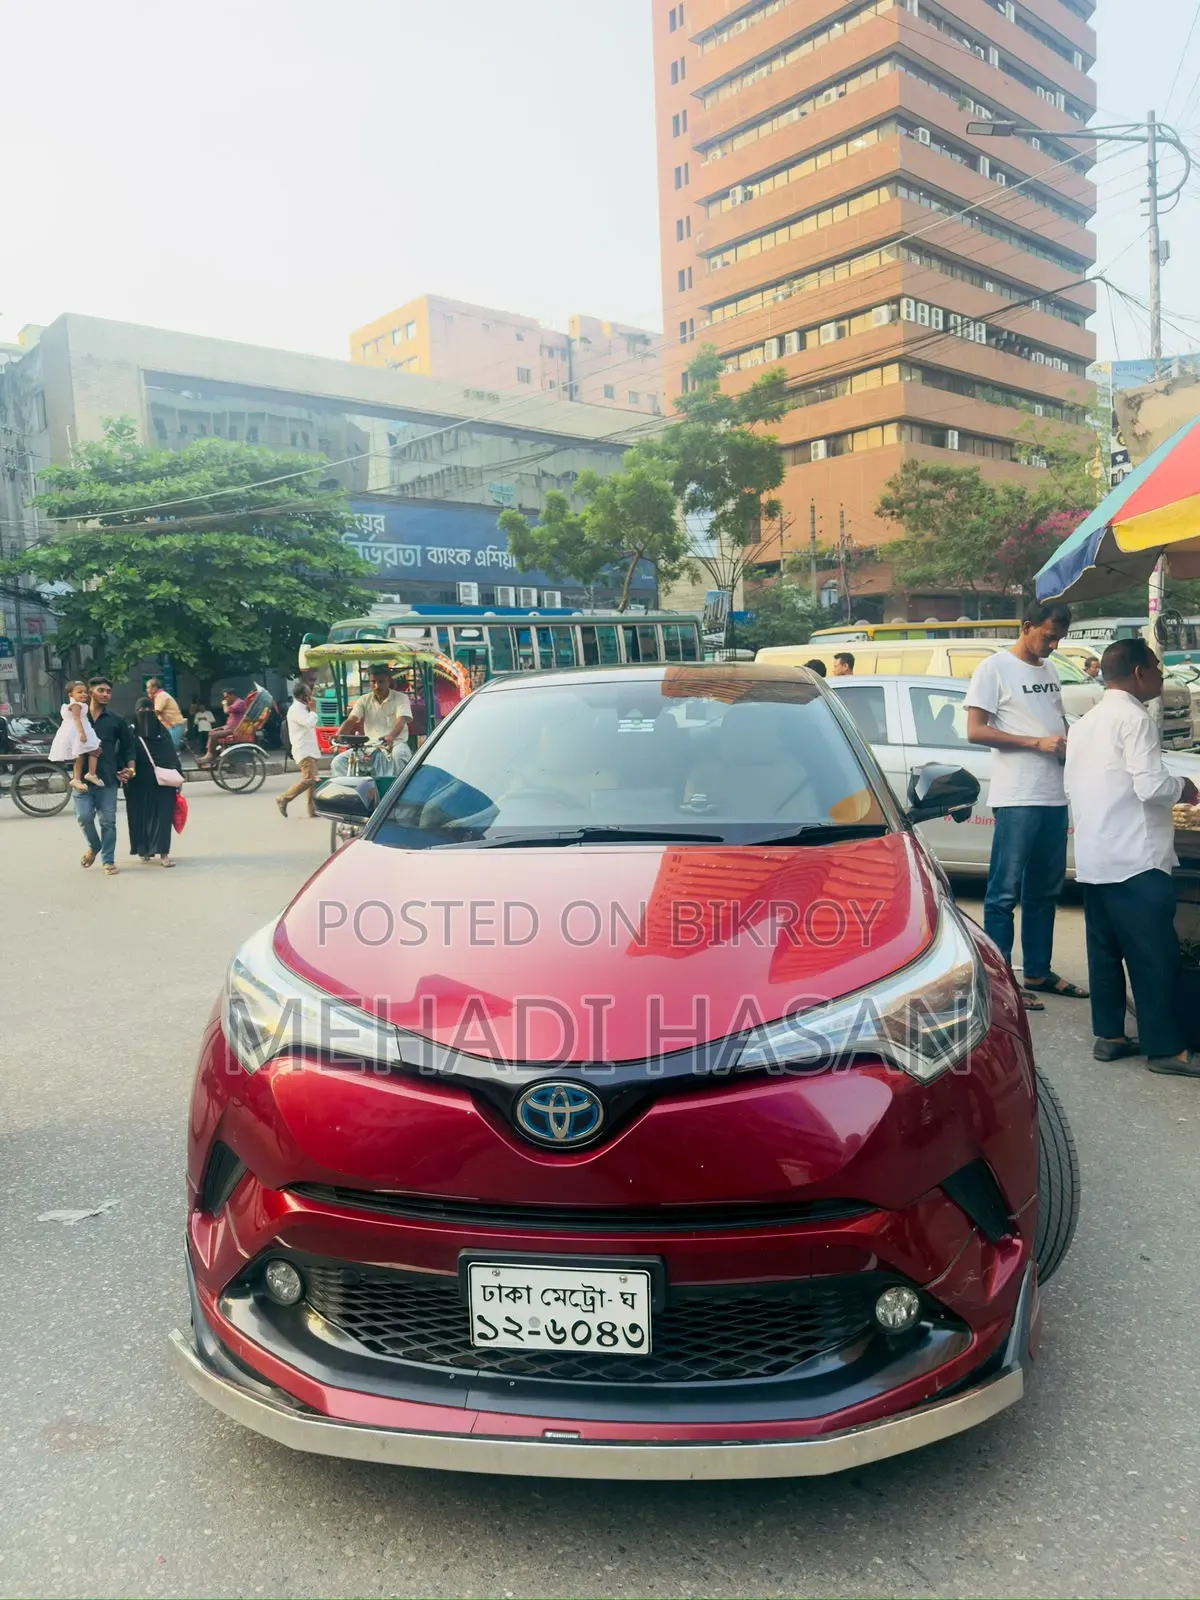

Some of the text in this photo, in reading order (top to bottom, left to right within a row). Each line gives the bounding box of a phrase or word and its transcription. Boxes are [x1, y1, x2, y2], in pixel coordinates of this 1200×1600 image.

[426, 546, 472, 566] ব্যাংক
[480, 1283, 533, 1304] ঢাকা
[476, 1314, 645, 1348] ১২-৬০৪৩
